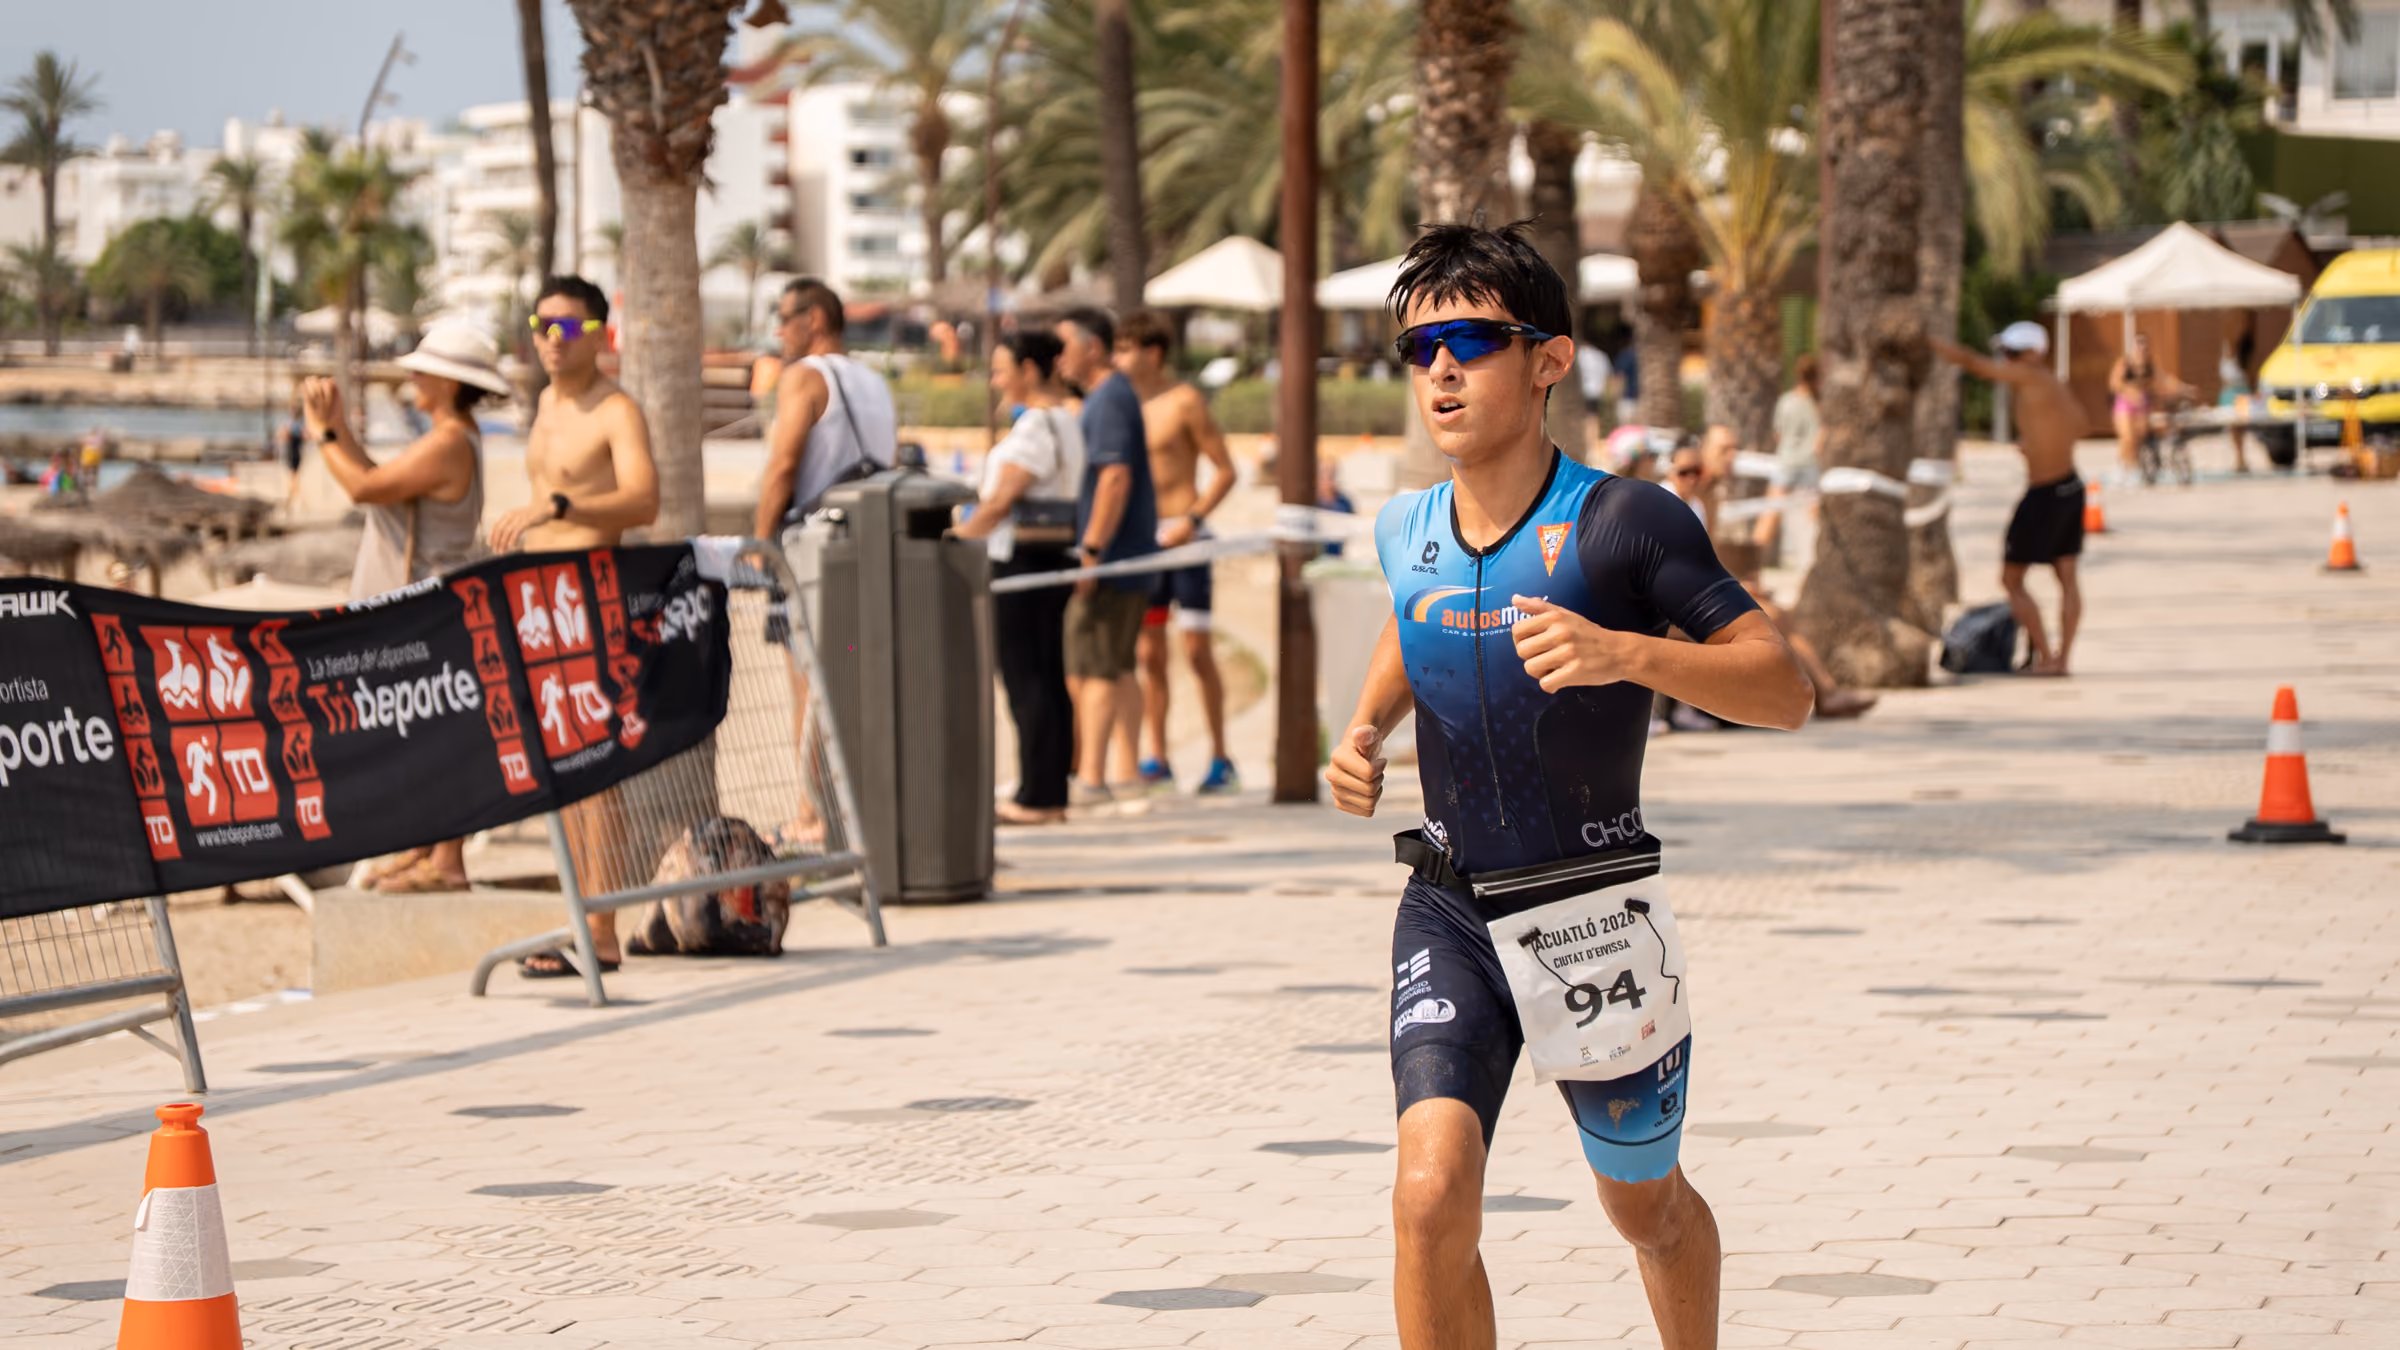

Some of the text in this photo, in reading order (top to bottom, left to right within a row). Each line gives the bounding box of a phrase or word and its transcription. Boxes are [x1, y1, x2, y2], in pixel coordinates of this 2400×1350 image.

[0, 590, 77, 620] AWK
[1442, 598, 1546, 630] autosm
[306, 660, 481, 738] Trideporte
[0, 706, 115, 788] porte
[222, 747, 270, 795] TD
[145, 815, 175, 845] TD
[1535, 907, 1637, 953] ACUATLÓ 2026
[1553, 938, 1632, 970] CIUTAT D'EIVISSA
[1564, 968, 1648, 1030] 94
